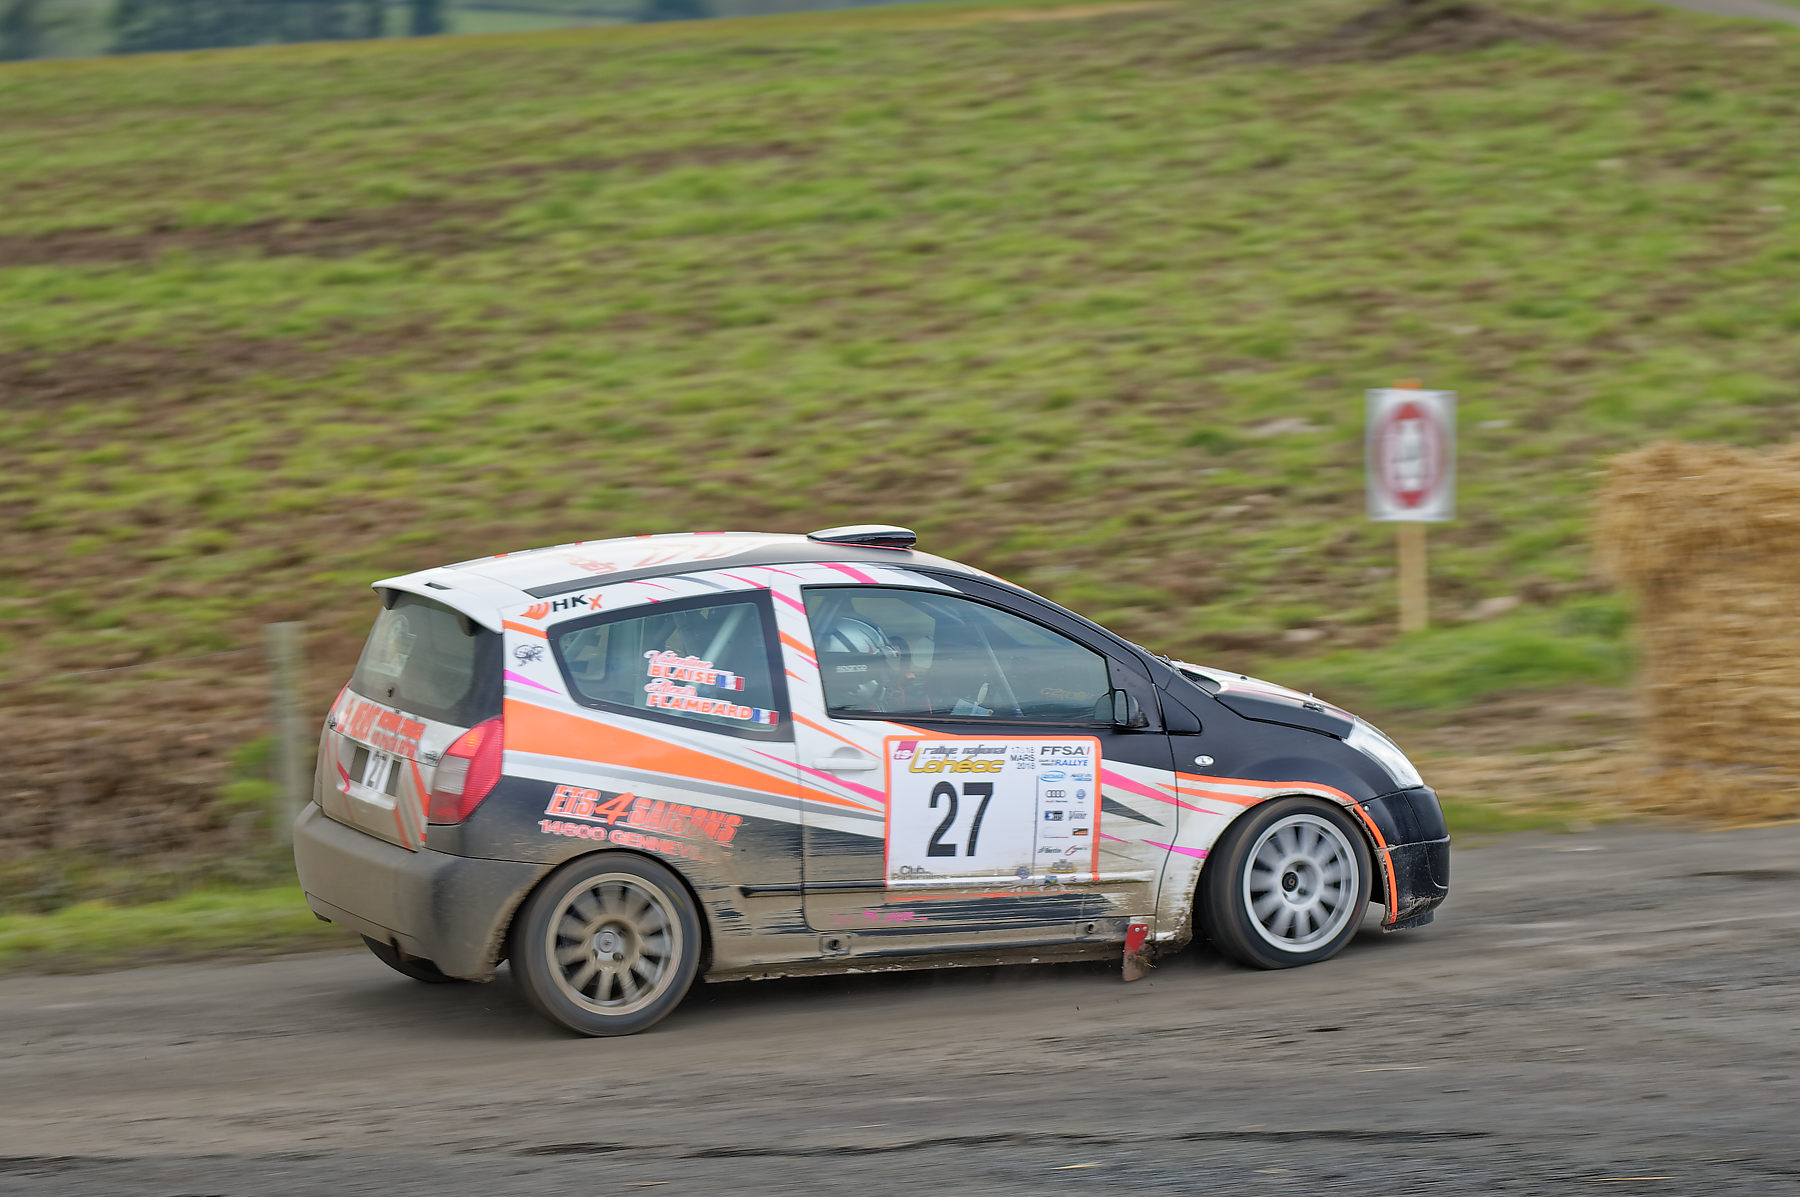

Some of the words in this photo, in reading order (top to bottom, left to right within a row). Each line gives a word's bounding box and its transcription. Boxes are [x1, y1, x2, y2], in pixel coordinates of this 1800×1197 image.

[648, 664, 717, 685] BLAISE
[647, 694, 753, 720] FLAMBARD
[908, 748, 1005, 773] Lohéac
[922, 746, 958, 757] rallye
[962, 745, 1007, 757] national
[1040, 746, 1085, 755] FFSA
[367, 757, 386, 789] 27
[546, 785, 601, 816] ETS
[594, 792, 636, 825] 4
[540, 820, 607, 841] 14600
[926, 781, 993, 857] 27
